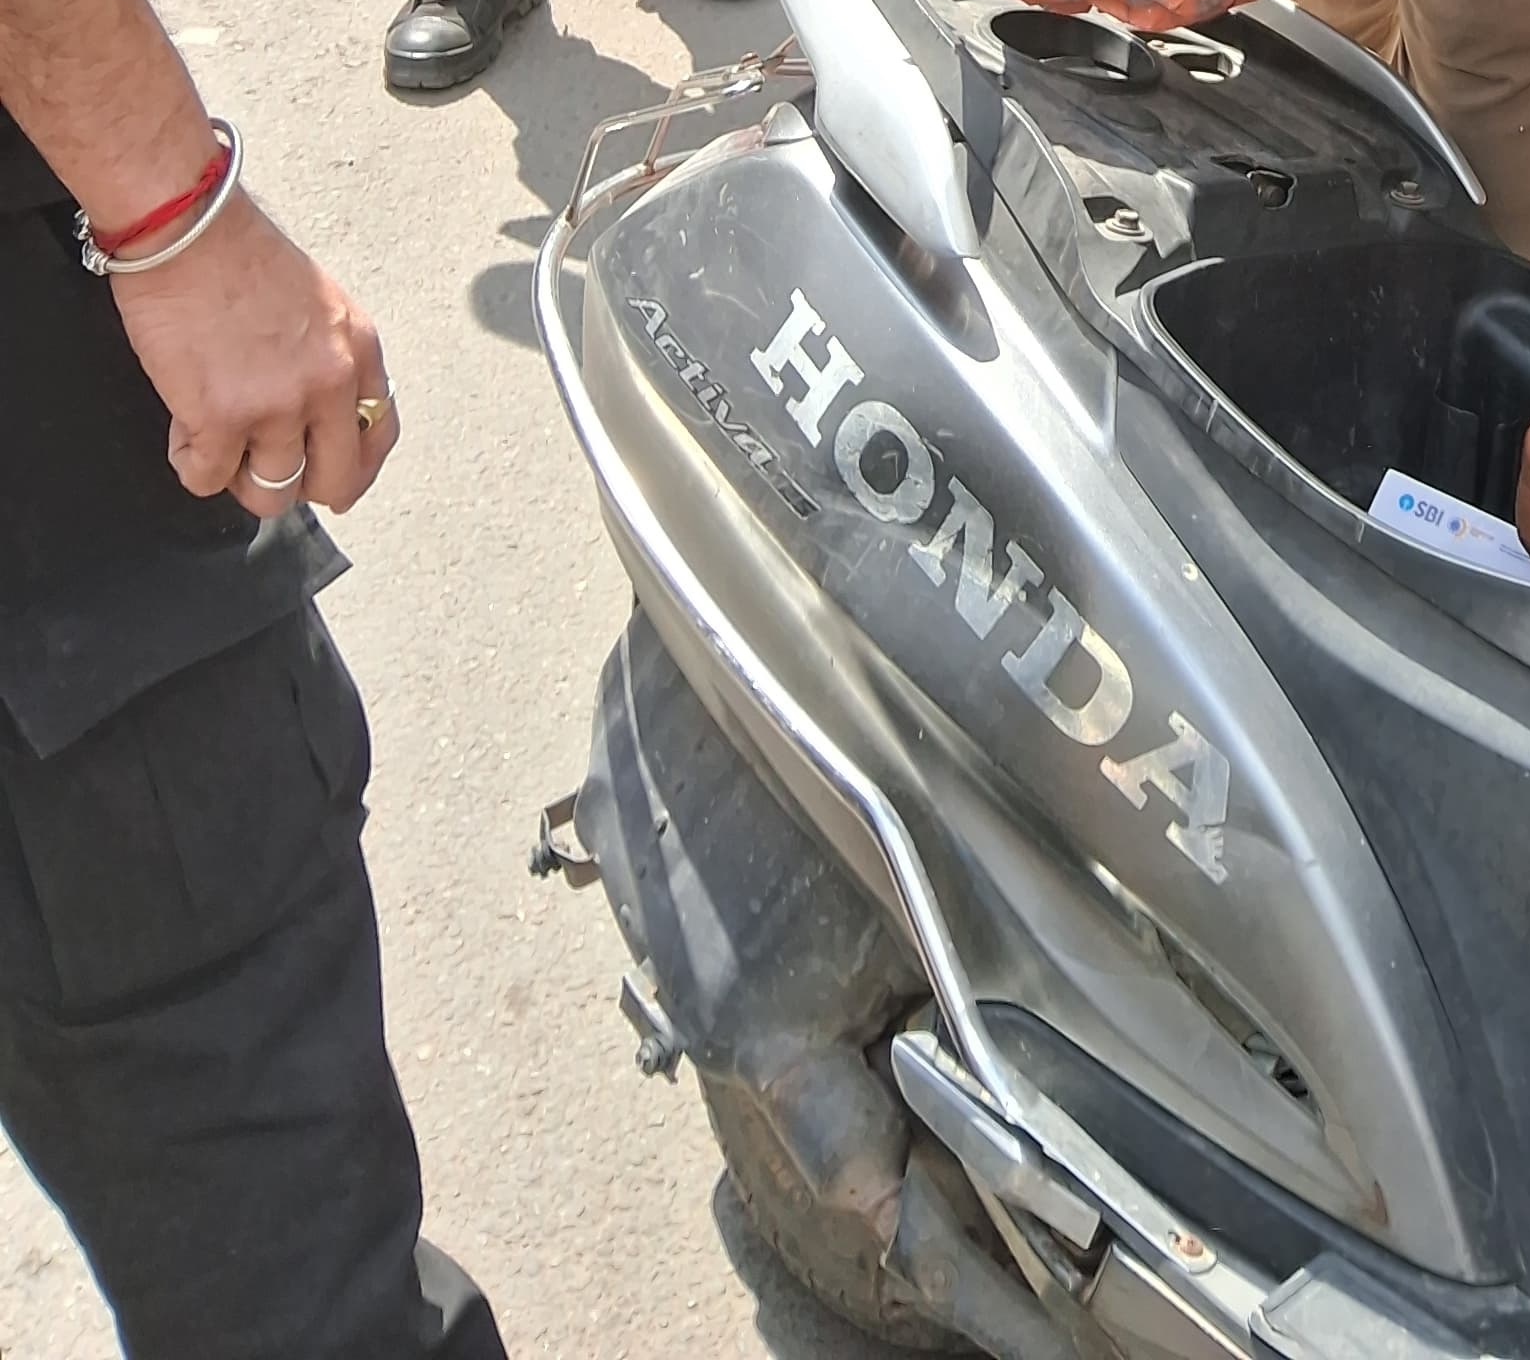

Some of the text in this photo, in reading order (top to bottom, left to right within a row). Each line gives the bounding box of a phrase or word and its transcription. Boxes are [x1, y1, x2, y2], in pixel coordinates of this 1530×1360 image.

[624, 295, 780, 476] Activa
[750, 287, 1229, 884] HONDA
[1414, 500, 1444, 526] SBI
